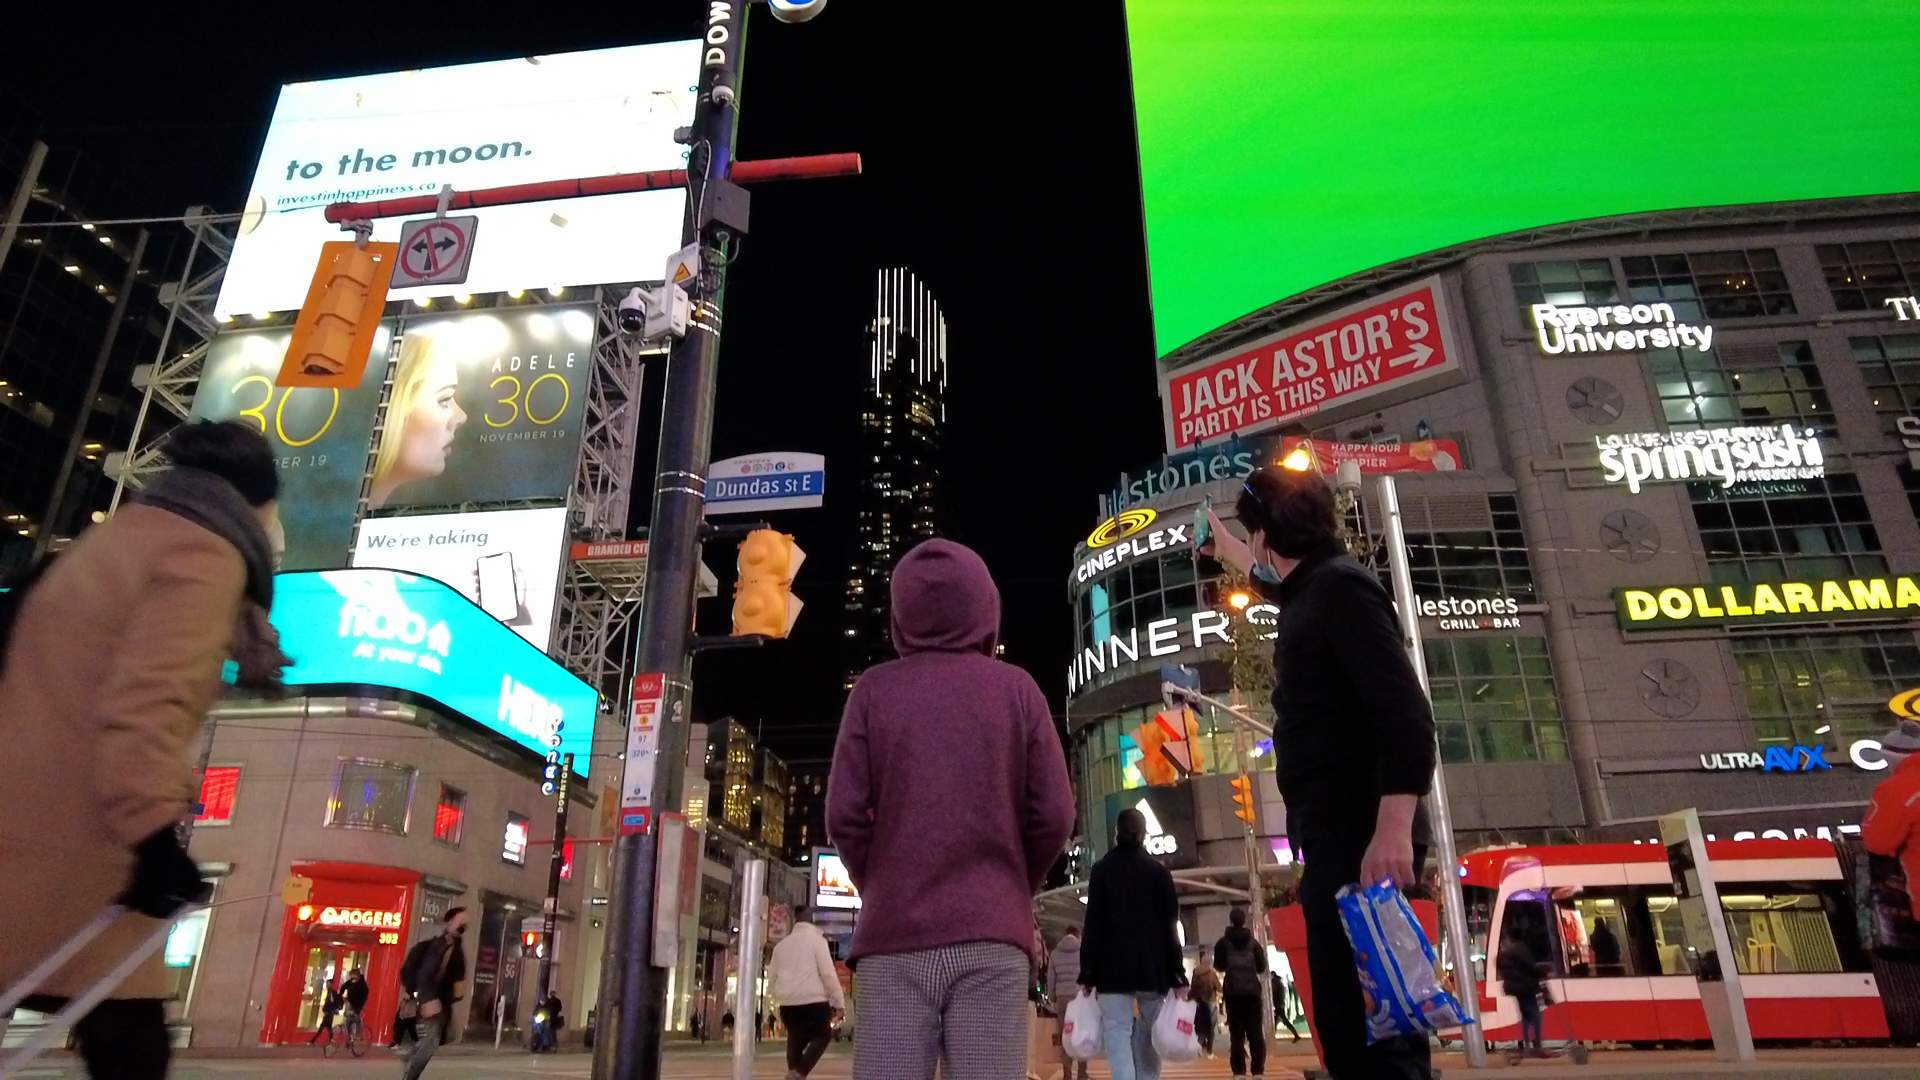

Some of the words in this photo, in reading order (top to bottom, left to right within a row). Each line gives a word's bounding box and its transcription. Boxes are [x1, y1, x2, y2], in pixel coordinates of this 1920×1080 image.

[286, 159, 323, 181] to
[337, 148, 397, 176] the
[411, 138, 533, 168] moon.
[277, 182, 436, 206] investinhappiness.ca
[1531, 302, 1674, 334] Ryerson
[1538, 324, 1713, 354] University
[491, 352, 575, 373] ADELE
[1179, 357, 1262, 420] JACK
[1272, 300, 1430, 388] ASTOR'S
[484, 373, 569, 428] 30
[1180, 402, 1246, 445] PARTY
[1251, 394, 1272, 421] IS
[1276, 377, 1327, 413] THIS
[1330, 356, 1383, 396] WAY
[480, 431, 547, 443] NOVEMBER
[552, 429, 565, 438] 19
[1331, 443, 1369, 453] HAPPY
[1370, 443, 1401, 452] HOUR
[309, 455, 327, 468] 19
[1332, 458, 1387, 468] HPIER
[715, 478, 780, 497] Dundas
[784, 479, 797, 492] St
[802, 475, 811, 491] E
[367, 533, 421, 550] We're
[428, 530, 490, 551] taking
[1077, 524, 1188, 583] CINEPLEX
[1624, 576, 1920, 622] DOLLARAMA
[1440, 619, 1480, 630] GRILL
[1493, 618, 1521, 628] BAR
[1068, 604, 1281, 699] WINNERS
[339, 909, 402, 928] ROGERS
[379, 932, 399, 945] 302
